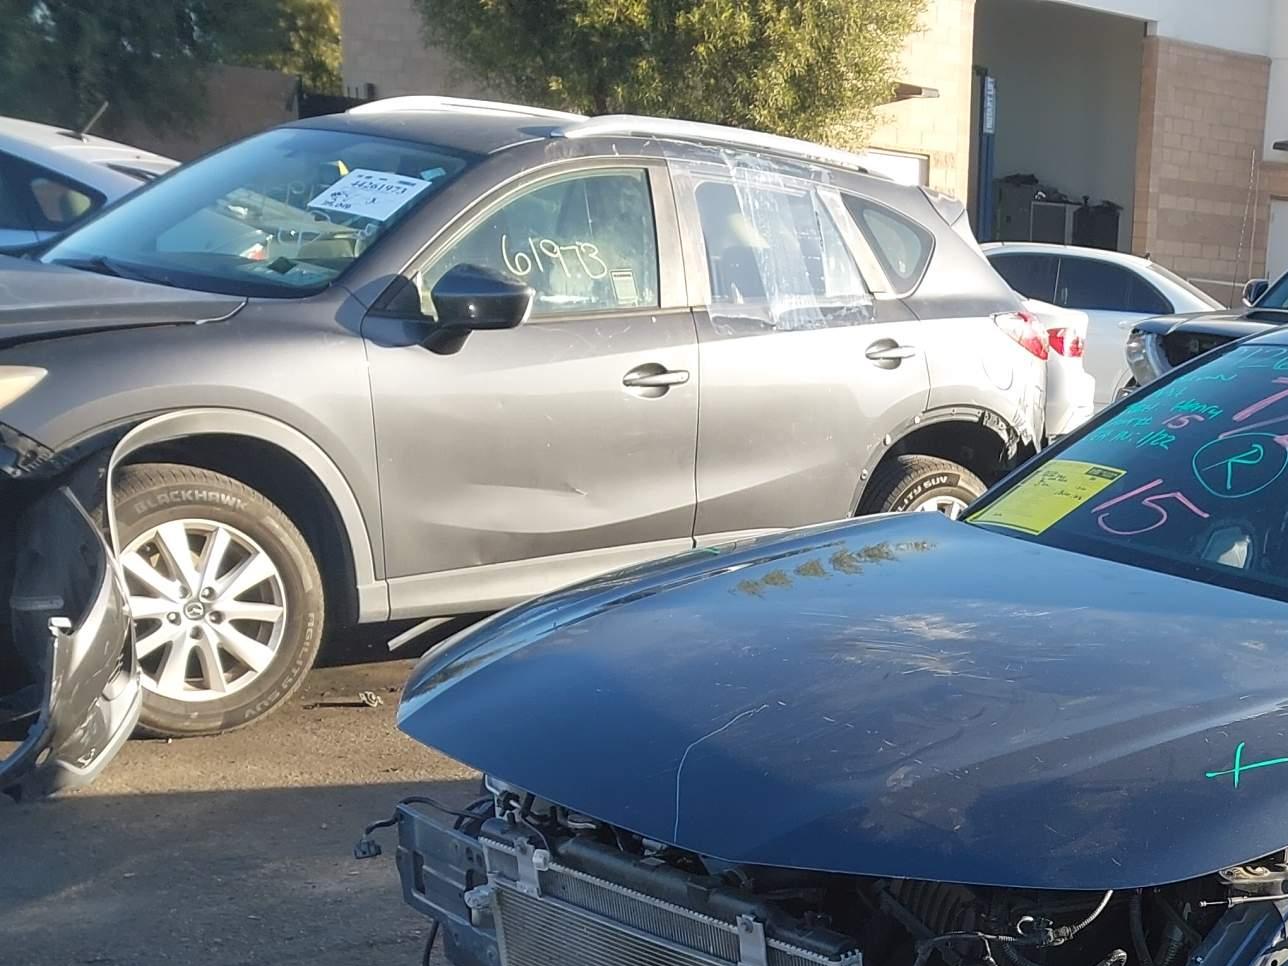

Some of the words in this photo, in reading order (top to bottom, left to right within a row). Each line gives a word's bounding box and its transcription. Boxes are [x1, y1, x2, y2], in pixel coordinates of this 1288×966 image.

[502, 234, 608, 279] 61973
[922, 476, 948, 489] SUV
[136, 489, 249, 514] BLACKHAWK
